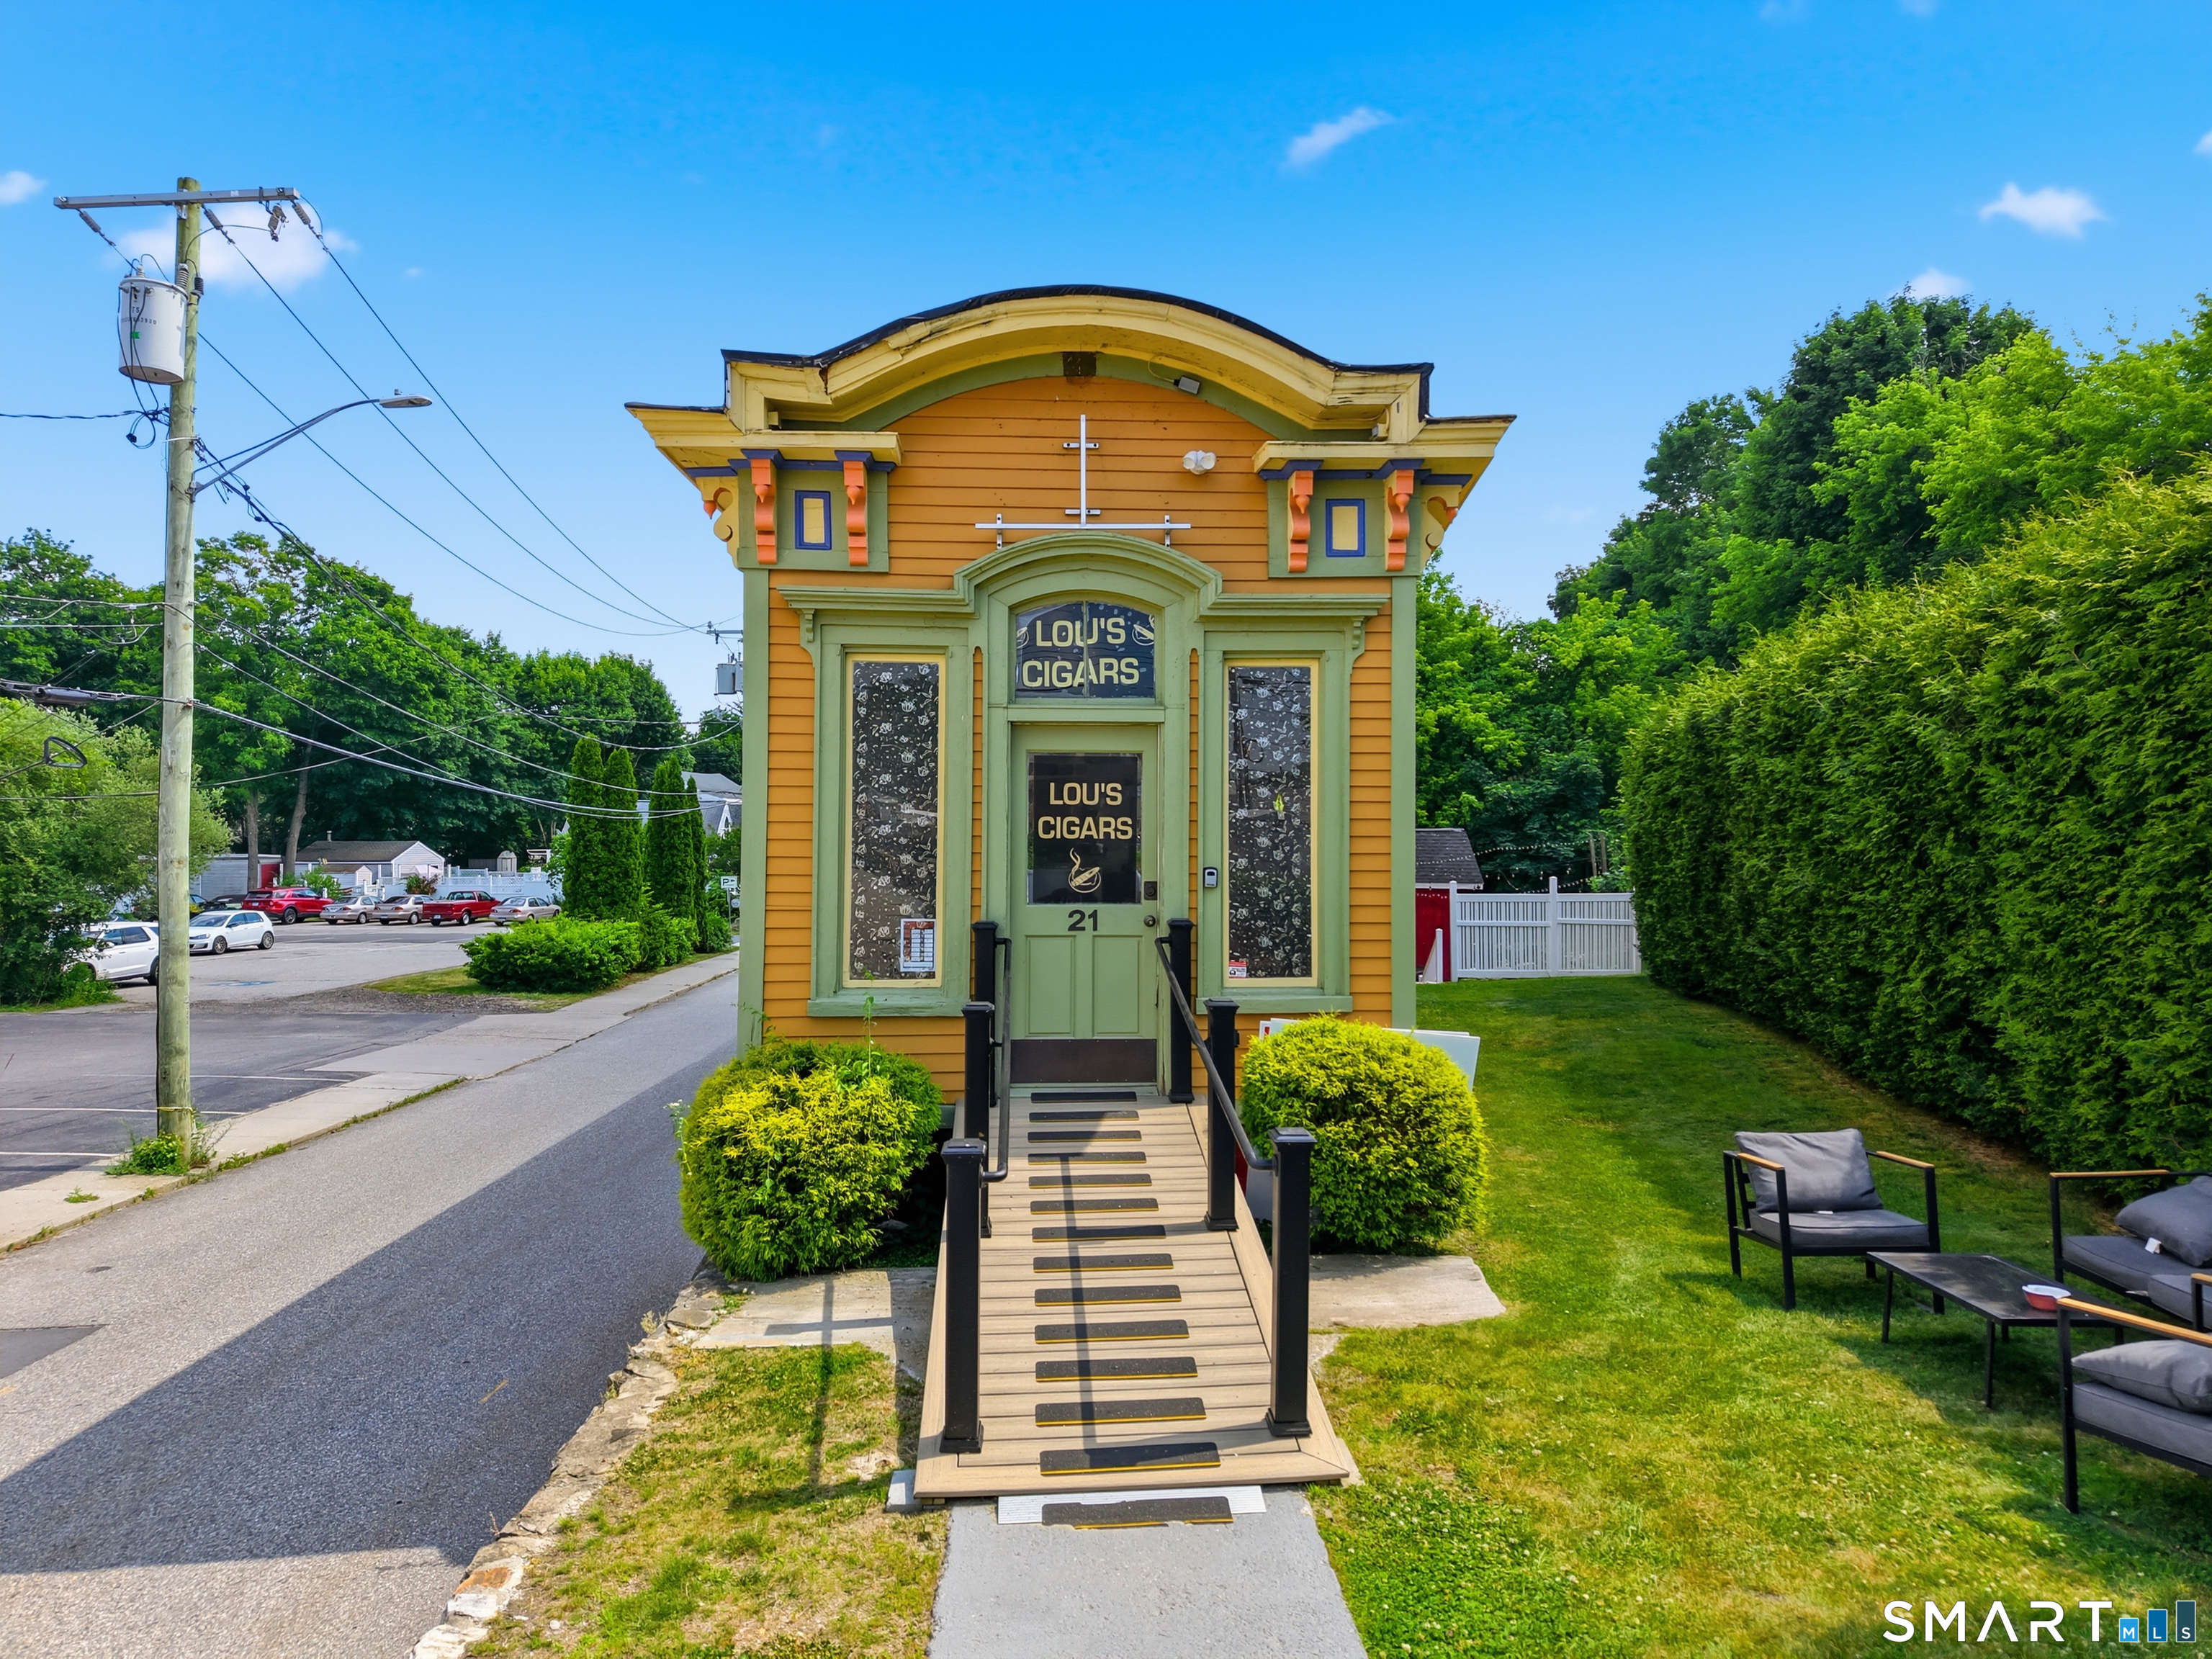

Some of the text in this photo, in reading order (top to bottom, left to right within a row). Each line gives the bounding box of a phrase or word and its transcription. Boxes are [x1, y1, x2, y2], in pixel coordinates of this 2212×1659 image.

[1035, 617, 1126, 647] LOU'S
[1022, 657, 1140, 688] CIGARS
[1049, 782, 1123, 806] LOU'S
[1038, 816, 1133, 840] CIGARS
[1067, 909, 1098, 932] 21
